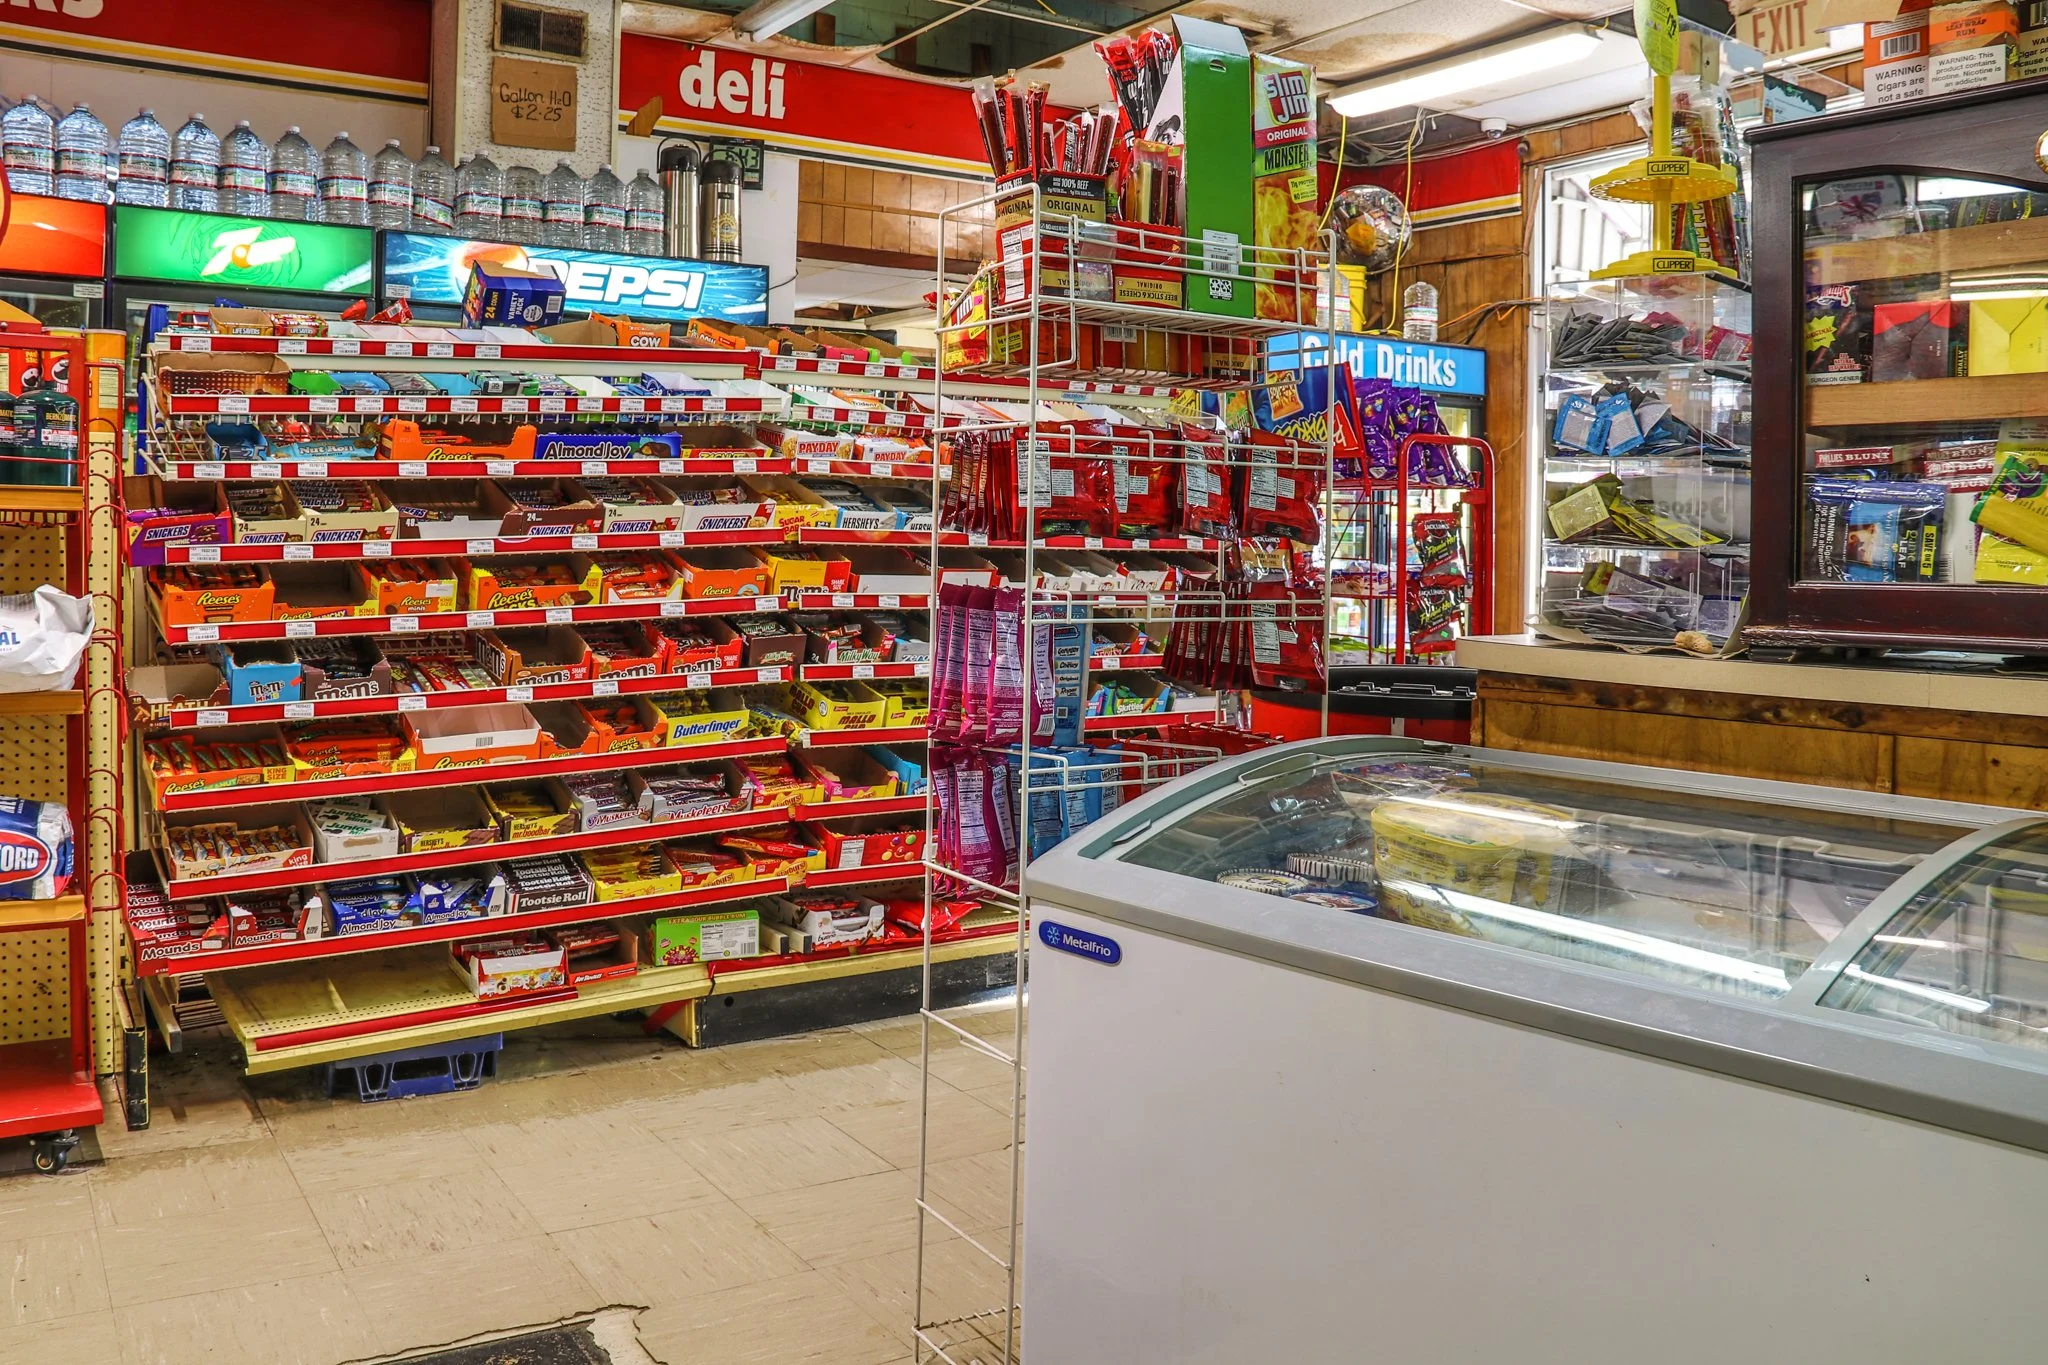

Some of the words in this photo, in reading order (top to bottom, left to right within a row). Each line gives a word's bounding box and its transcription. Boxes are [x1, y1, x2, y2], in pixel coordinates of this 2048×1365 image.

[1752, 2, 1807, 56] EXIT
[1939, 54, 1976, 66] WARNING:
[1875, 64, 1927, 80] WARNING:
[1936, 65, 1964, 74] product
[1963, 60, 1997, 69] contains
[1931, 73, 1962, 82] nicotine.
[1963, 68, 1993, 77] Nicotine
[1955, 76, 1988, 85] addictive
[679, 50, 787, 120] deli
[1876, 80, 1906, 93] Cigars
[1907, 77, 1925, 87] are
[500, 83, 544, 105] Gallon
[1878, 94, 1893, 103] not
[1894, 93, 1901, 101] a
[1903, 87, 1925, 99] safe
[1266, 126, 1309, 141] ORIGINAL
[1263, 143, 1310, 171] MONSTER
[1650, 163, 1687, 174] CLIPPER
[1061, 178, 1076, 188] 100%
[1076, 179, 1089, 190] BEEF
[1046, 199, 1096, 214] ORIGINAL
[1655, 260, 1691, 270] CLIPPER
[1136, 281, 1163, 289] ORIGINAL
[484, 303, 497, 320] 24
[507, 291, 519, 320] VARIETY
[515, 297, 525, 315] PACK
[630, 335, 661, 348] COW
[1376, 343, 1457, 388] Drinks
[299, 446, 323, 454] Nut
[325, 445, 354, 454] Roll
[427, 447, 473, 460] Reese's
[543, 442, 604, 459] Almond
[602, 444, 631, 460] Joy
[799, 440, 840, 454] PAYDAY
[875, 451, 906, 461] PAYDAY
[1818, 453, 1844, 463] PHILLIES
[1844, 452, 1890, 461] BLUNT
[527, 513, 537, 522] 24
[608, 509, 618, 518] 24
[239, 523, 249, 532] 24
[310, 517, 320, 526] 24
[405, 518, 415, 527] 48
[611, 521, 652, 533] SNICKERS
[701, 517, 748, 530] SNICKERS
[778, 515, 805, 527] SUGAR
[842, 517, 880, 530] HERSHEY'S
[1827, 505, 1838, 541] WARNING:
[146, 525, 191, 540] SNICKERS
[313, 530, 362, 542] SNICKERS
[530, 525, 573, 536] SNICKERS
[242, 534, 285, 544] SNICKERS
[1924, 532, 1935, 553] SAVE
[1898, 540, 1907, 569] LEAF
[702, 585, 733, 596] Reese's
[196, 592, 241, 605] Reese's
[401, 596, 432, 606] Reese's
[489, 589, 534, 609] Reese's
[280, 610, 312, 620] Reese's
[724, 654, 739, 662] SHARE
[838, 650, 862, 662] Milky
[861, 649, 881, 660] Way
[1059, 661, 1079, 669] Chewy
[1116, 702, 1144, 715] Skittles
[838, 714, 877, 725] MALLO
[673, 718, 742, 739] Butterfinger
[608, 736, 639, 750] Reese's
[268, 773, 287, 781] SIZE
[310, 768, 343, 781] Reese's
[166, 778, 206, 793] Reese's
[323, 808, 368, 818] Junior
[669, 801, 729, 820] Musketeers
[345, 816, 373, 824] Mints
[597, 806, 646, 829] Musketeers
[326, 822, 371, 832] Junior
[513, 822, 538, 832] HERSHEY'S
[420, 837, 444, 847] HERSHEY'S
[288, 853, 308, 865] king
[520, 893, 563, 908] Tootsie
[563, 890, 587, 902] Roll
[131, 914, 188, 930] Mounds
[425, 911, 454, 923] Almond
[453, 909, 468, 919] Joy
[339, 921, 379, 935] Almond
[379, 918, 396, 931] Joy
[236, 931, 280, 945] Mounds
[817, 932, 837, 942] bueno
[141, 941, 200, 961] Mounds
[1062, 934, 1112, 958] Metalfrio
